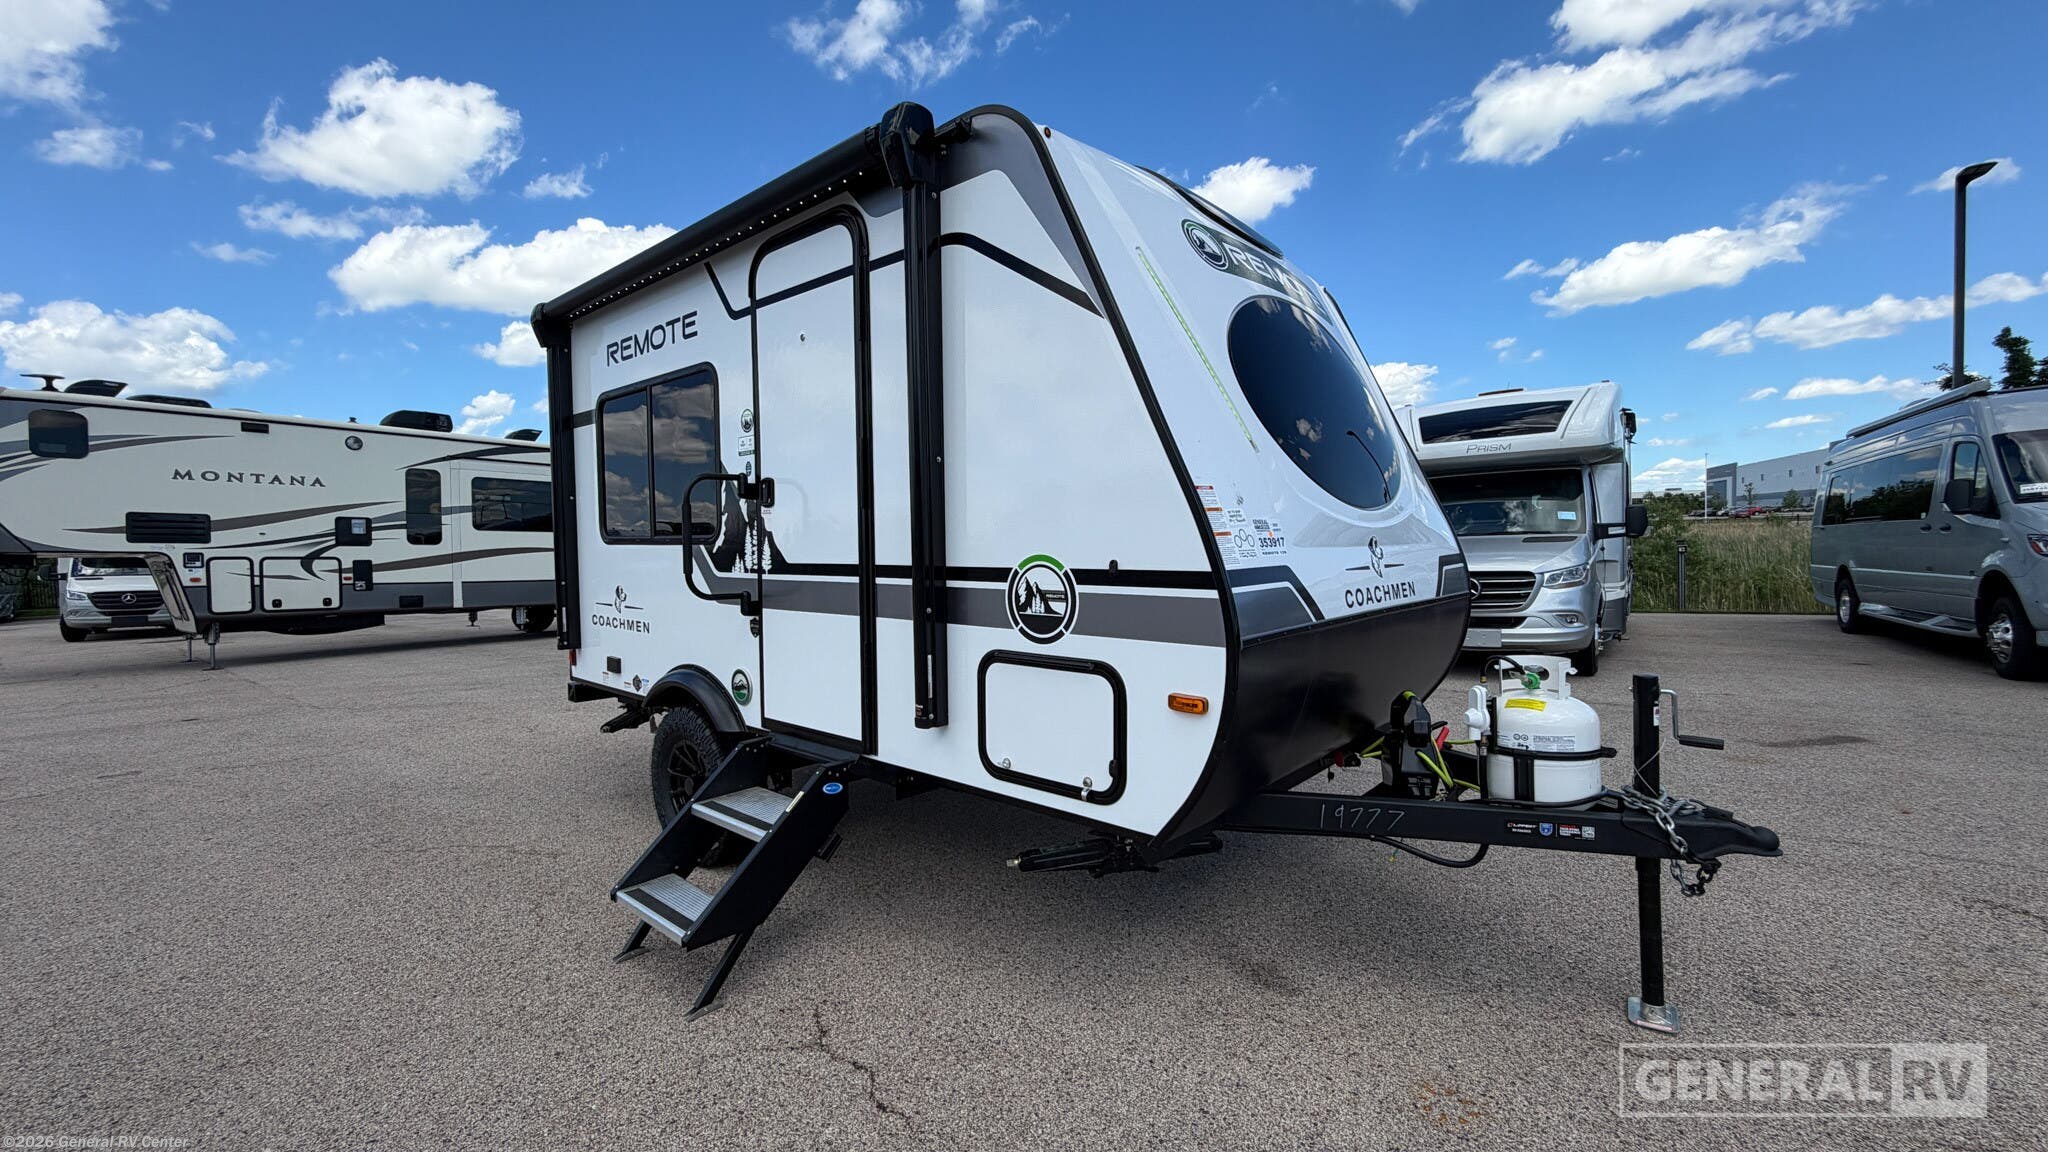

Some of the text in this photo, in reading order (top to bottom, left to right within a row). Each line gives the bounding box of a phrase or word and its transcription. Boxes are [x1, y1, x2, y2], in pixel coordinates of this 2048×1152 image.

[606, 310, 698, 367] REMOTE
[1466, 443, 1512, 454] PRISM
[171, 468, 326, 488] MONTANA
[1258, 537, 1285, 548] 353917
[1345, 581, 1416, 608] COACHMEN
[591, 614, 650, 634] COACHMEN
[1320, 803, 1405, 831] 19777
